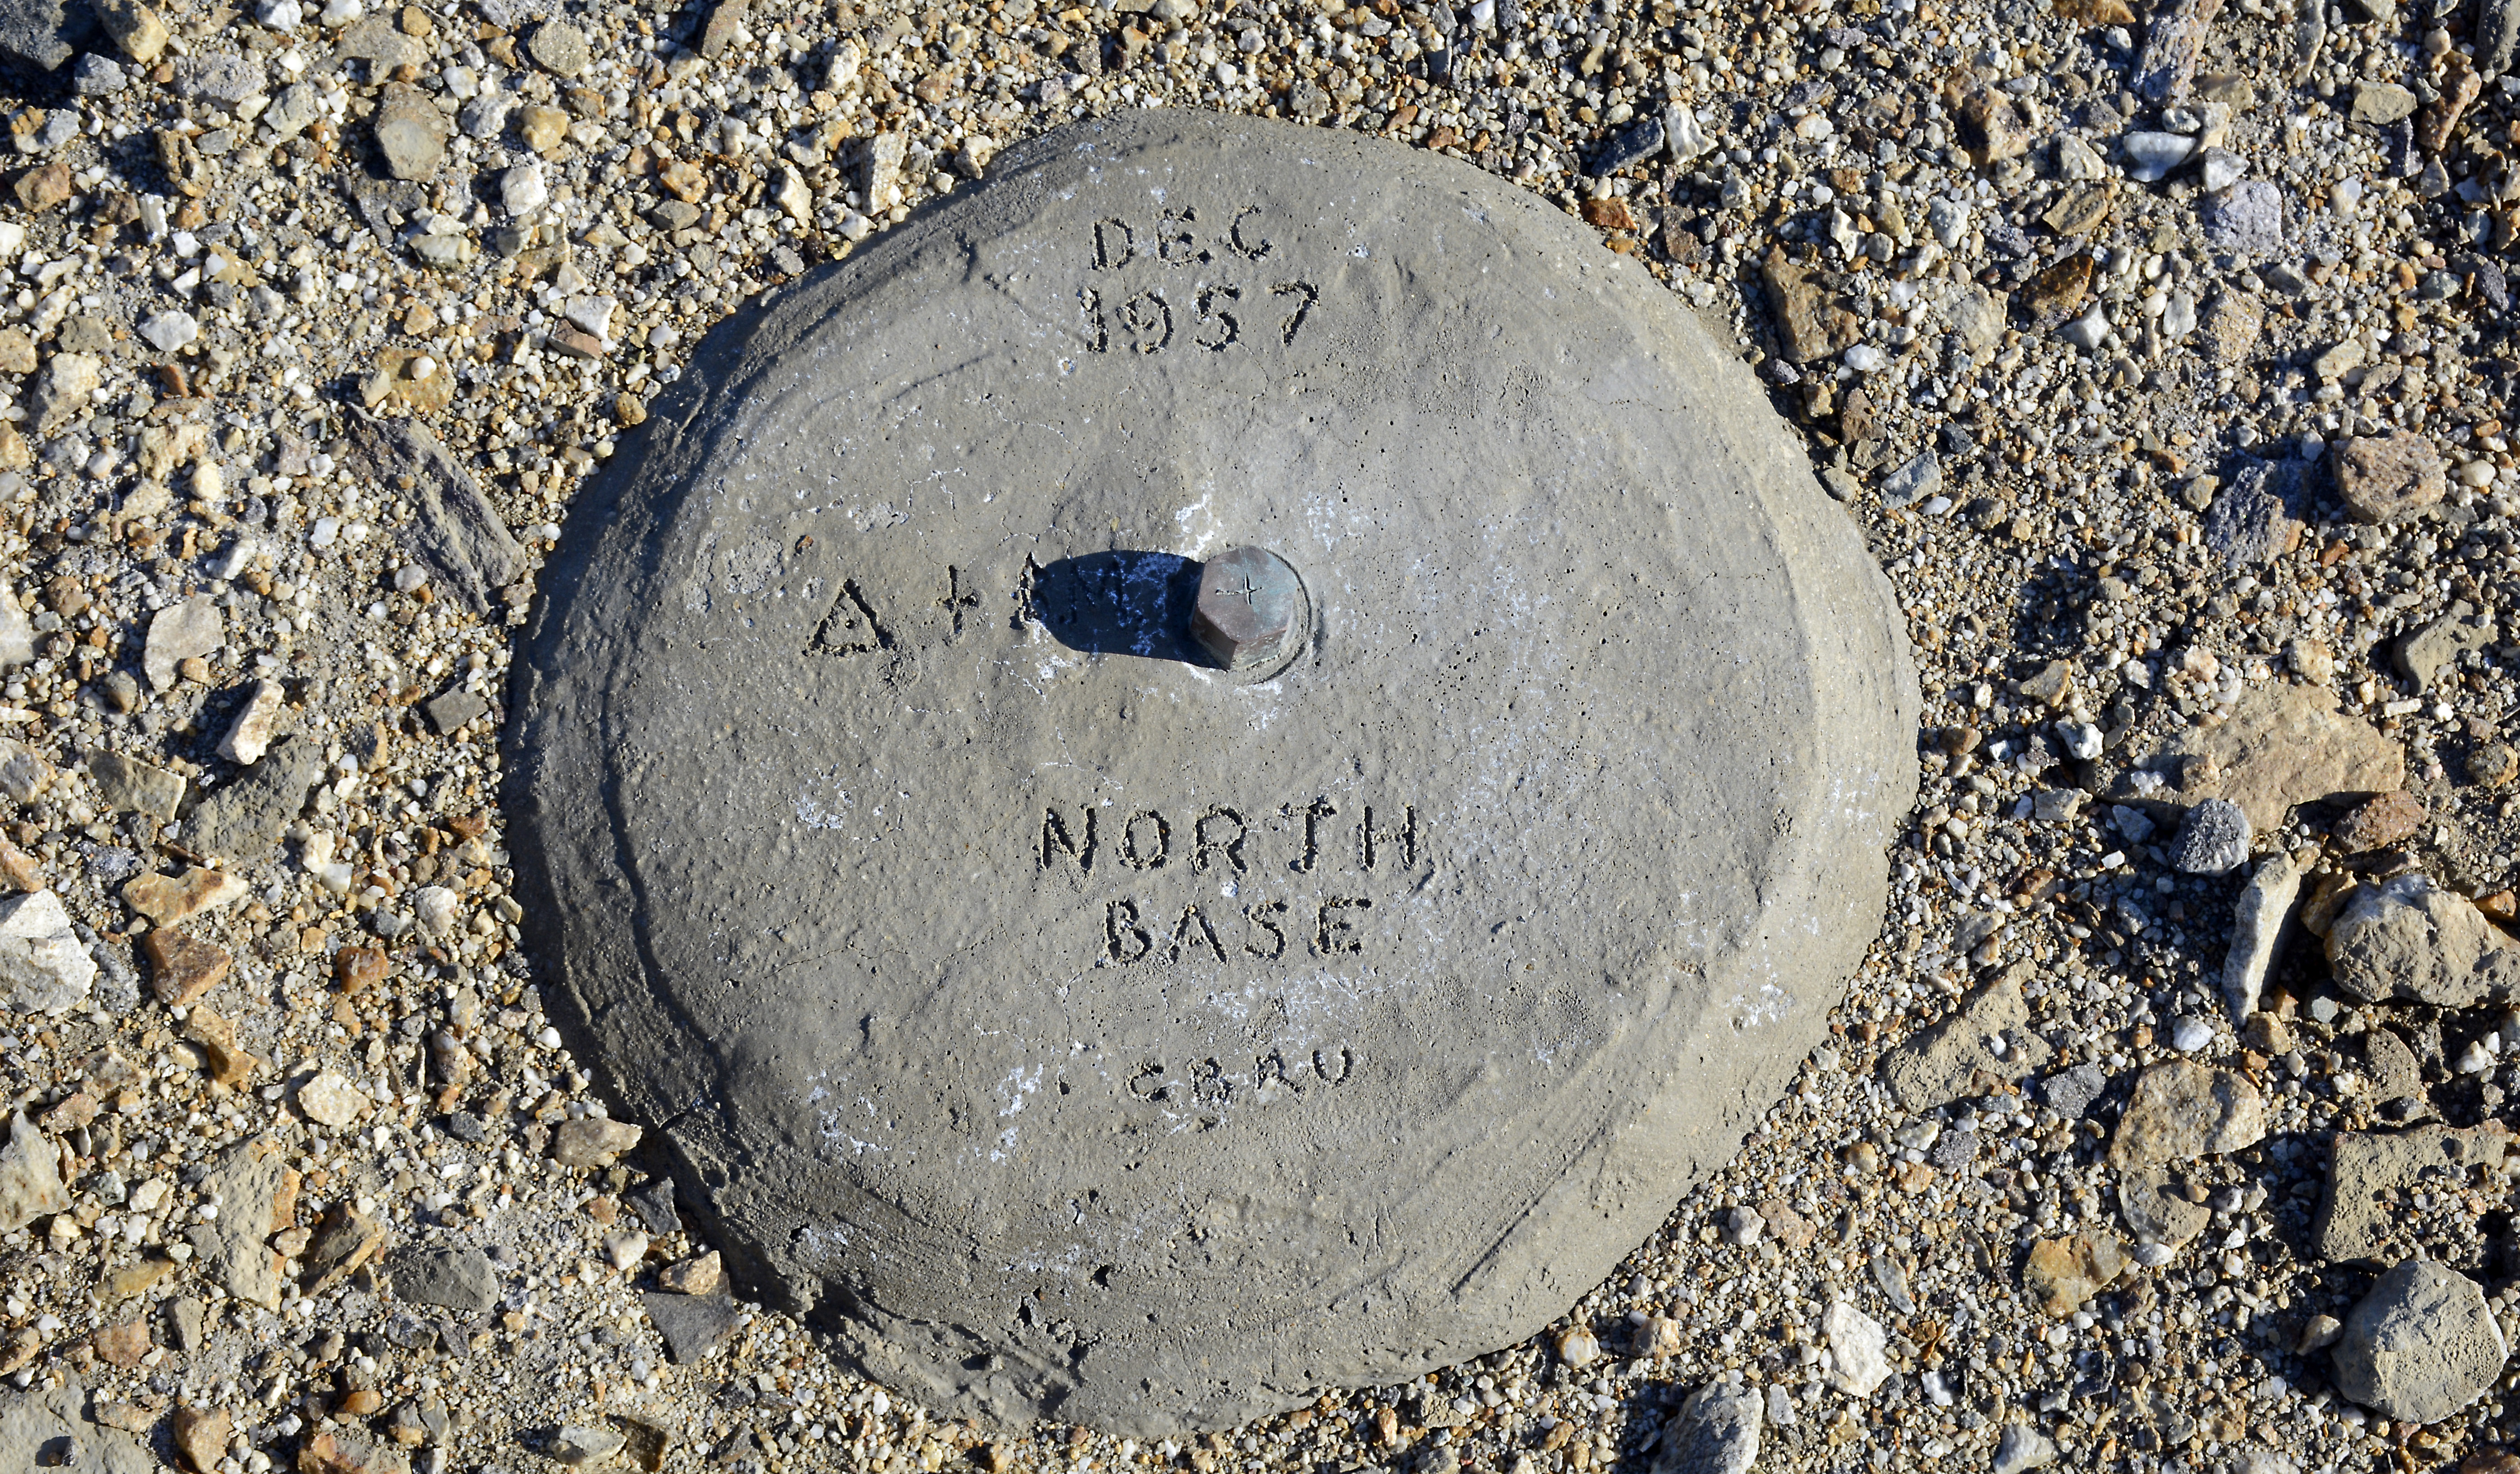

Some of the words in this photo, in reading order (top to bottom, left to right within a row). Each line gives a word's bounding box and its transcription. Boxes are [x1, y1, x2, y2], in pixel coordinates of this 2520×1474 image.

[1091, 205, 1273, 271] DEC
[1077, 279, 1319, 354] 1957
[1033, 796, 1418, 874] NORTH
[1101, 897, 1372, 964] BASE
